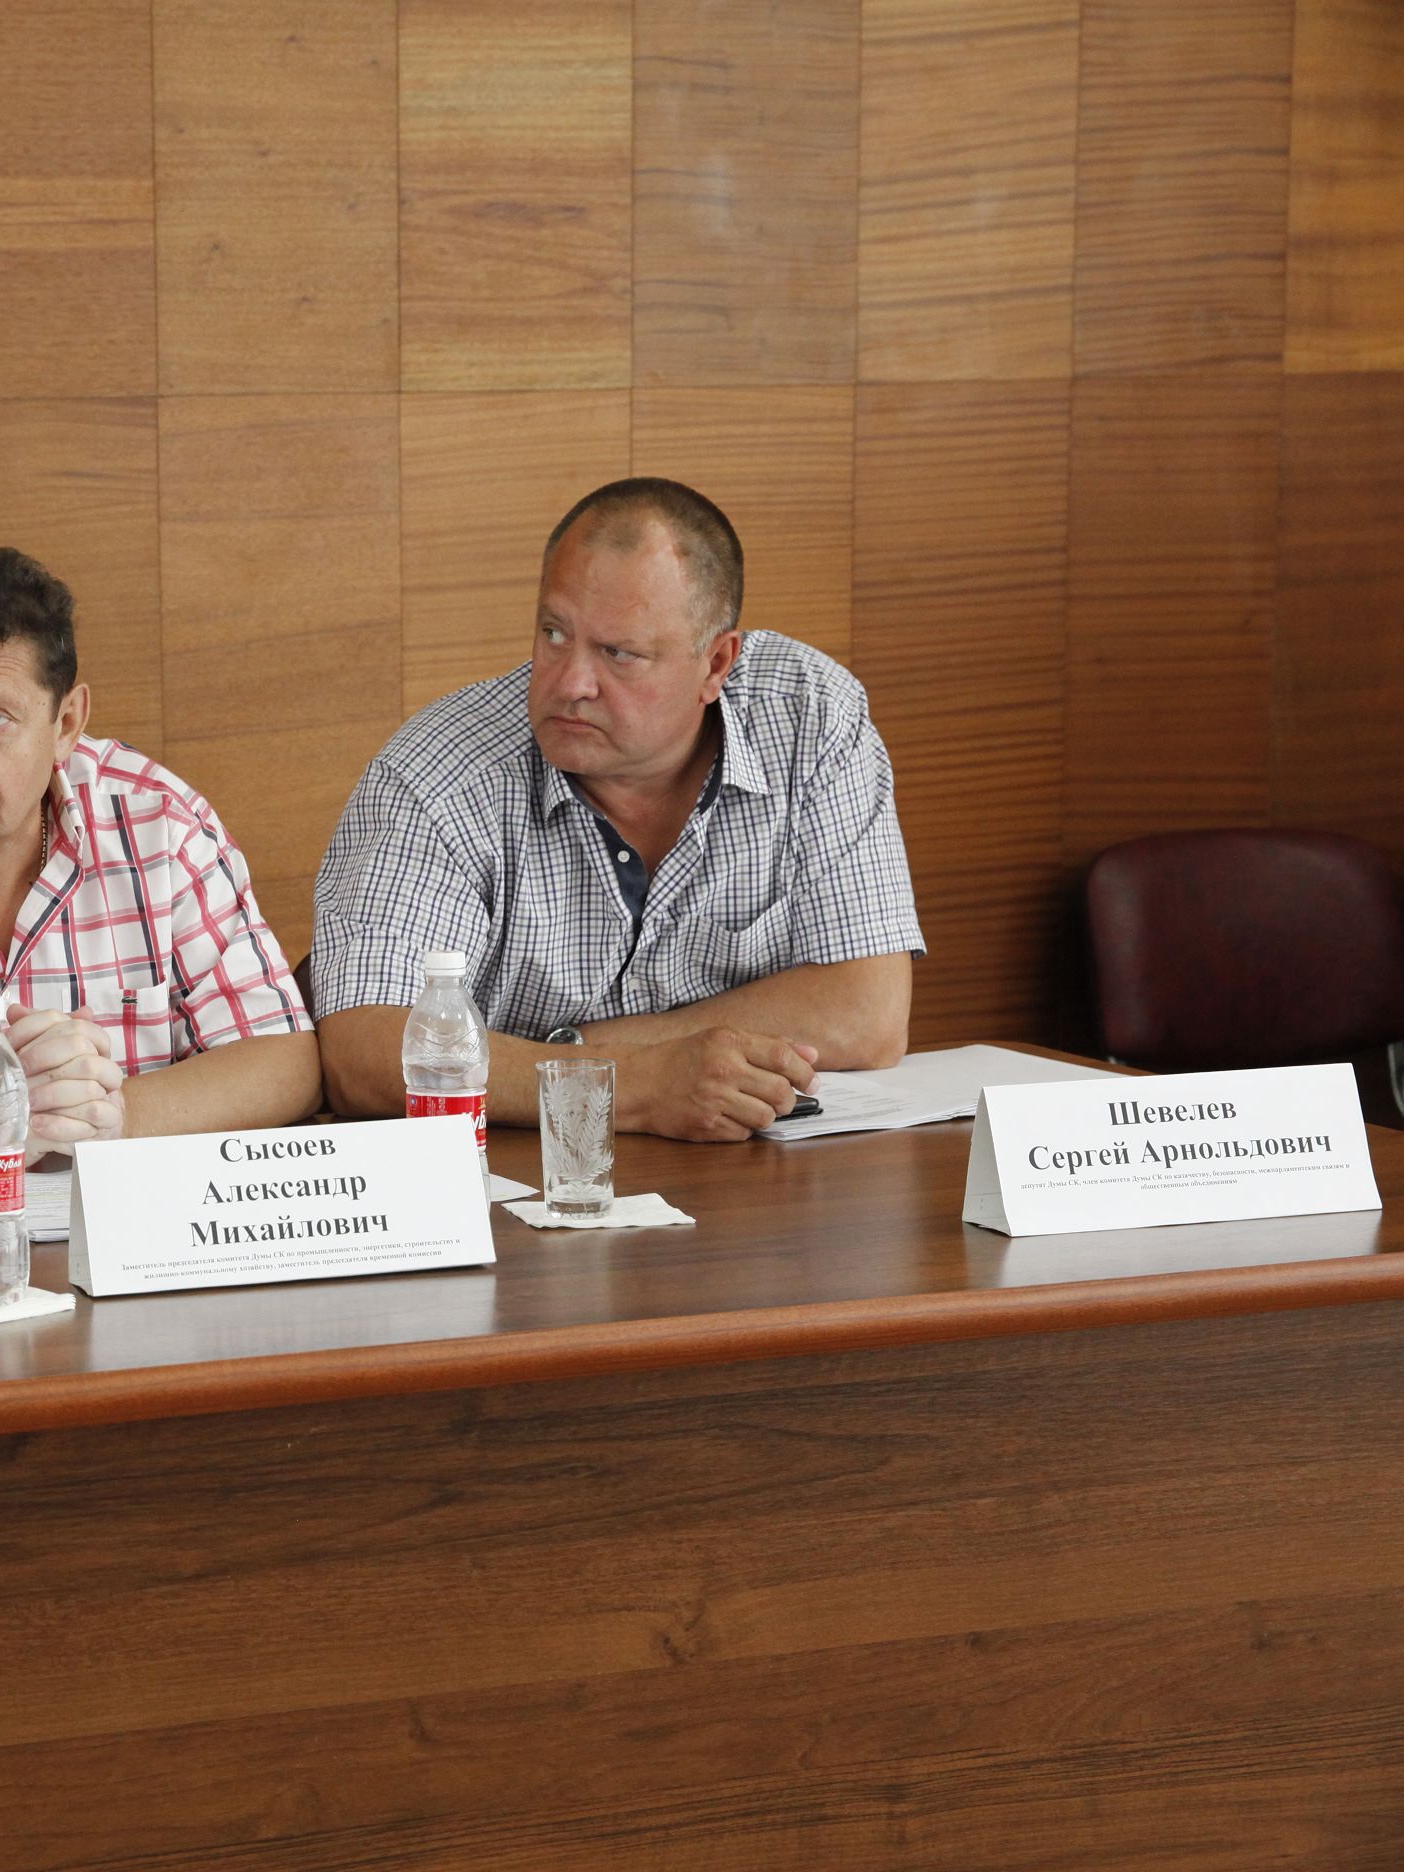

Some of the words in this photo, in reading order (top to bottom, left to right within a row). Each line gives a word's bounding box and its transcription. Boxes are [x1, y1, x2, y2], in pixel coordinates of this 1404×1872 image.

[1107, 1101, 1237, 1126] Шевелев
[219, 1138, 336, 1163] Сысоев
[1028, 1141, 1130, 1175] Сергей
[1140, 1135, 1332, 1169] Арнольдович
[202, 1175, 367, 1205] Александр
[189, 1213, 389, 1247] Михайлович
